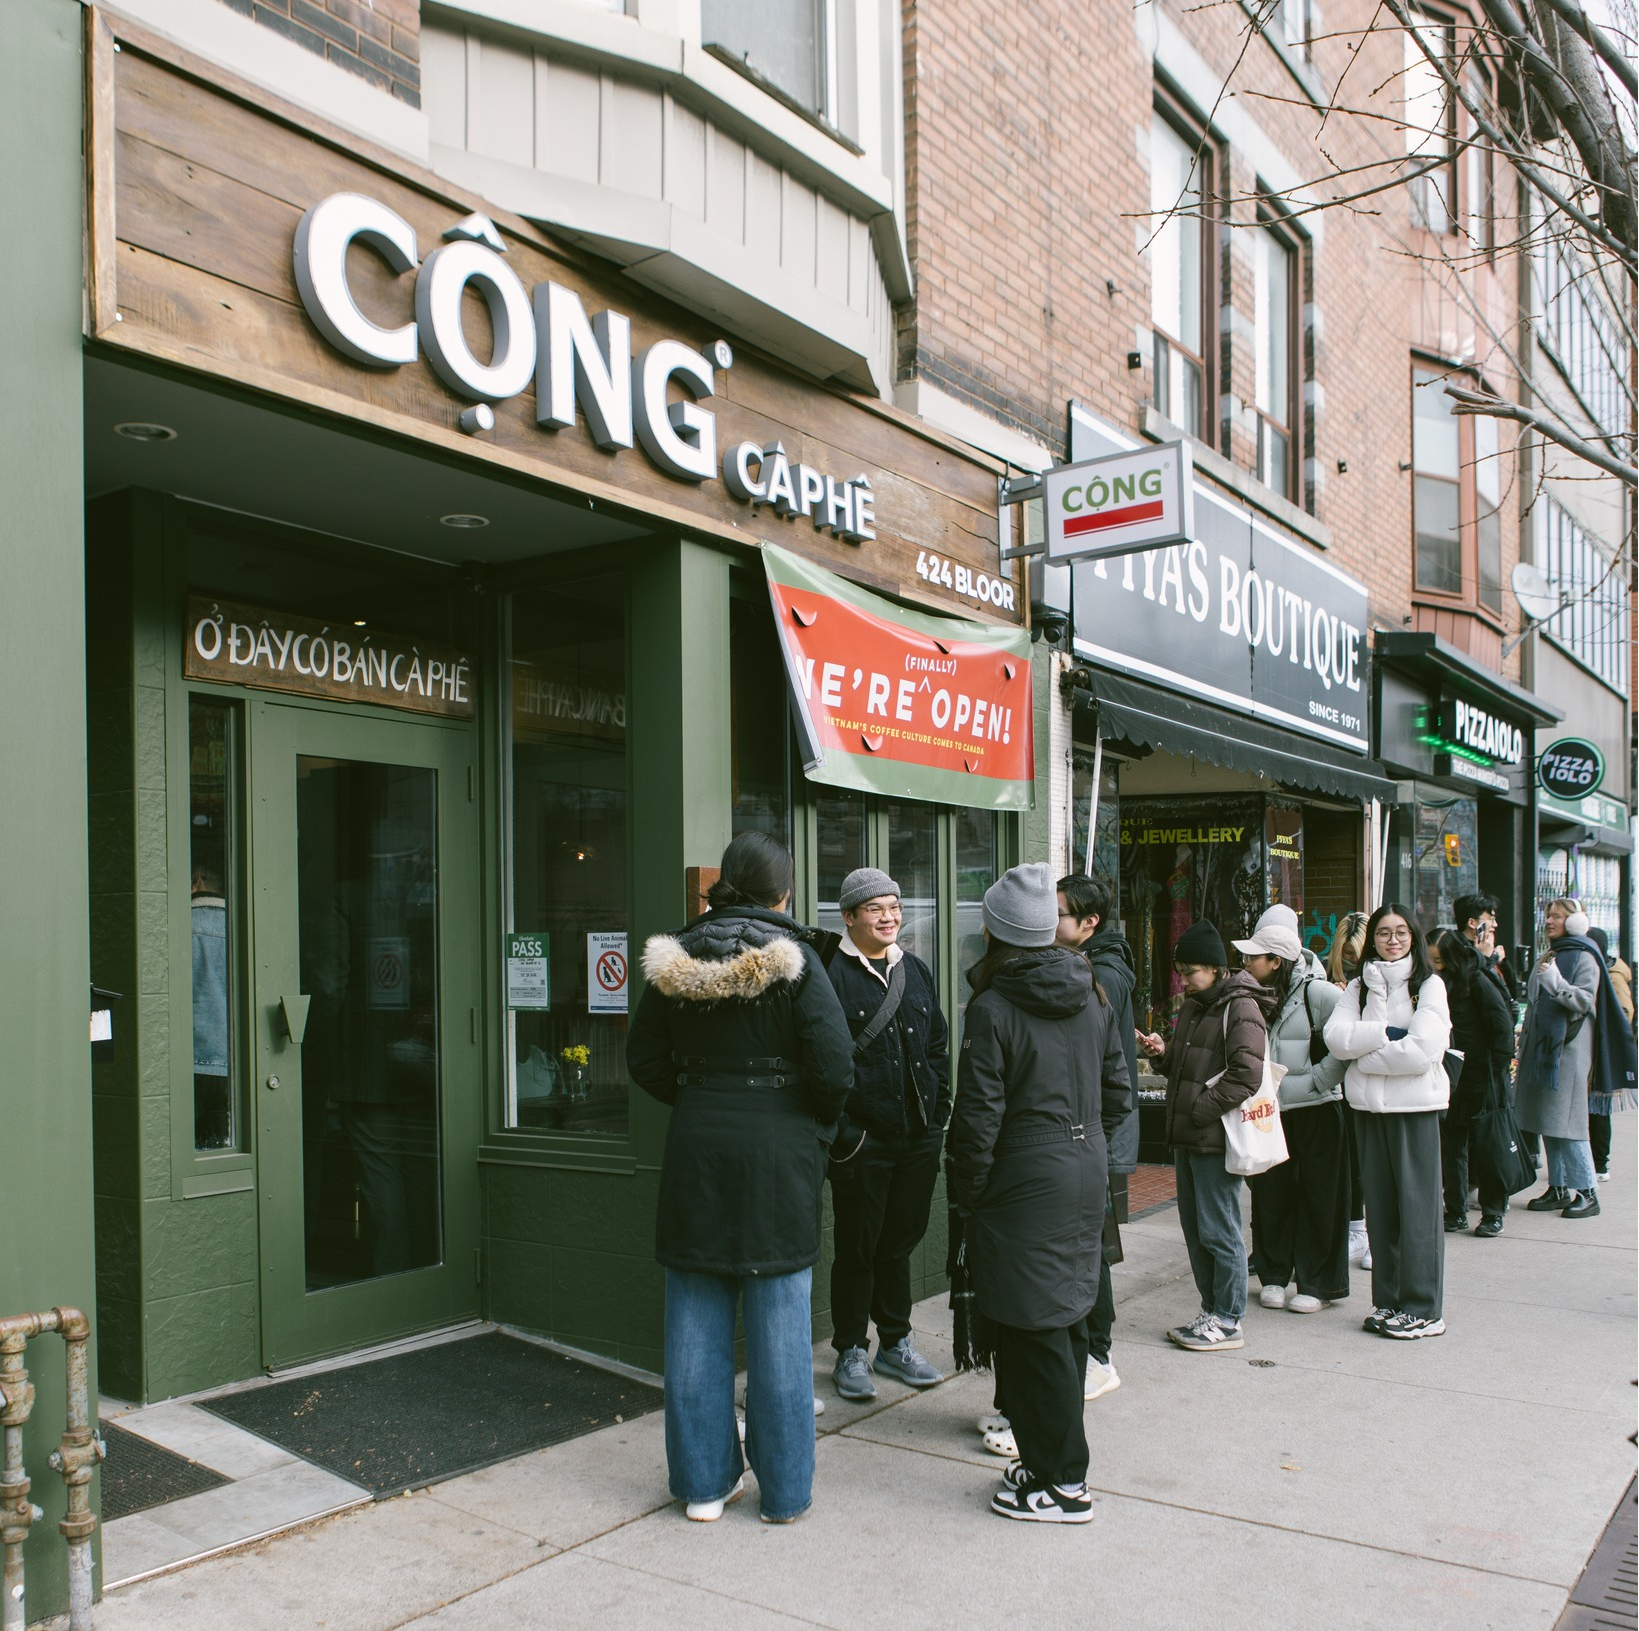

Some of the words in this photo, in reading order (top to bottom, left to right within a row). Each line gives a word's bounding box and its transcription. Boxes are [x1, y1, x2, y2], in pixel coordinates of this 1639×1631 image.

[294, 191, 718, 482] CỘNG
[1062, 469, 1162, 513] CỘNG
[916, 551, 953, 589] 424
[954, 564, 1015, 612] BLOOR
[1094, 539, 1210, 622] YA'S
[1219, 554, 1360, 692] BOUTIQUE
[904, 653, 957, 677] (FINALLY)
[823, 714, 868, 732] VIETNAM'S
[870, 724, 900, 738] COFFEE
[901, 730, 932, 744] CULTURE
[933, 736, 954, 749] COMES
[954, 741, 962, 750] TO
[962, 743, 985, 756] CANADA
[931, 688, 1012, 744] OPEN!
[1308, 700, 1339, 723] SINCE
[1340, 713, 1360, 732] 1971
[1456, 699, 1522, 765] PIZZAIOLO
[1549, 767, 1592, 785] IOLO
[1138, 826, 1245, 845] JEWELLERY
[1270, 848, 1300, 860] BOUTIQUE
[512, 941, 543, 957] PASS
